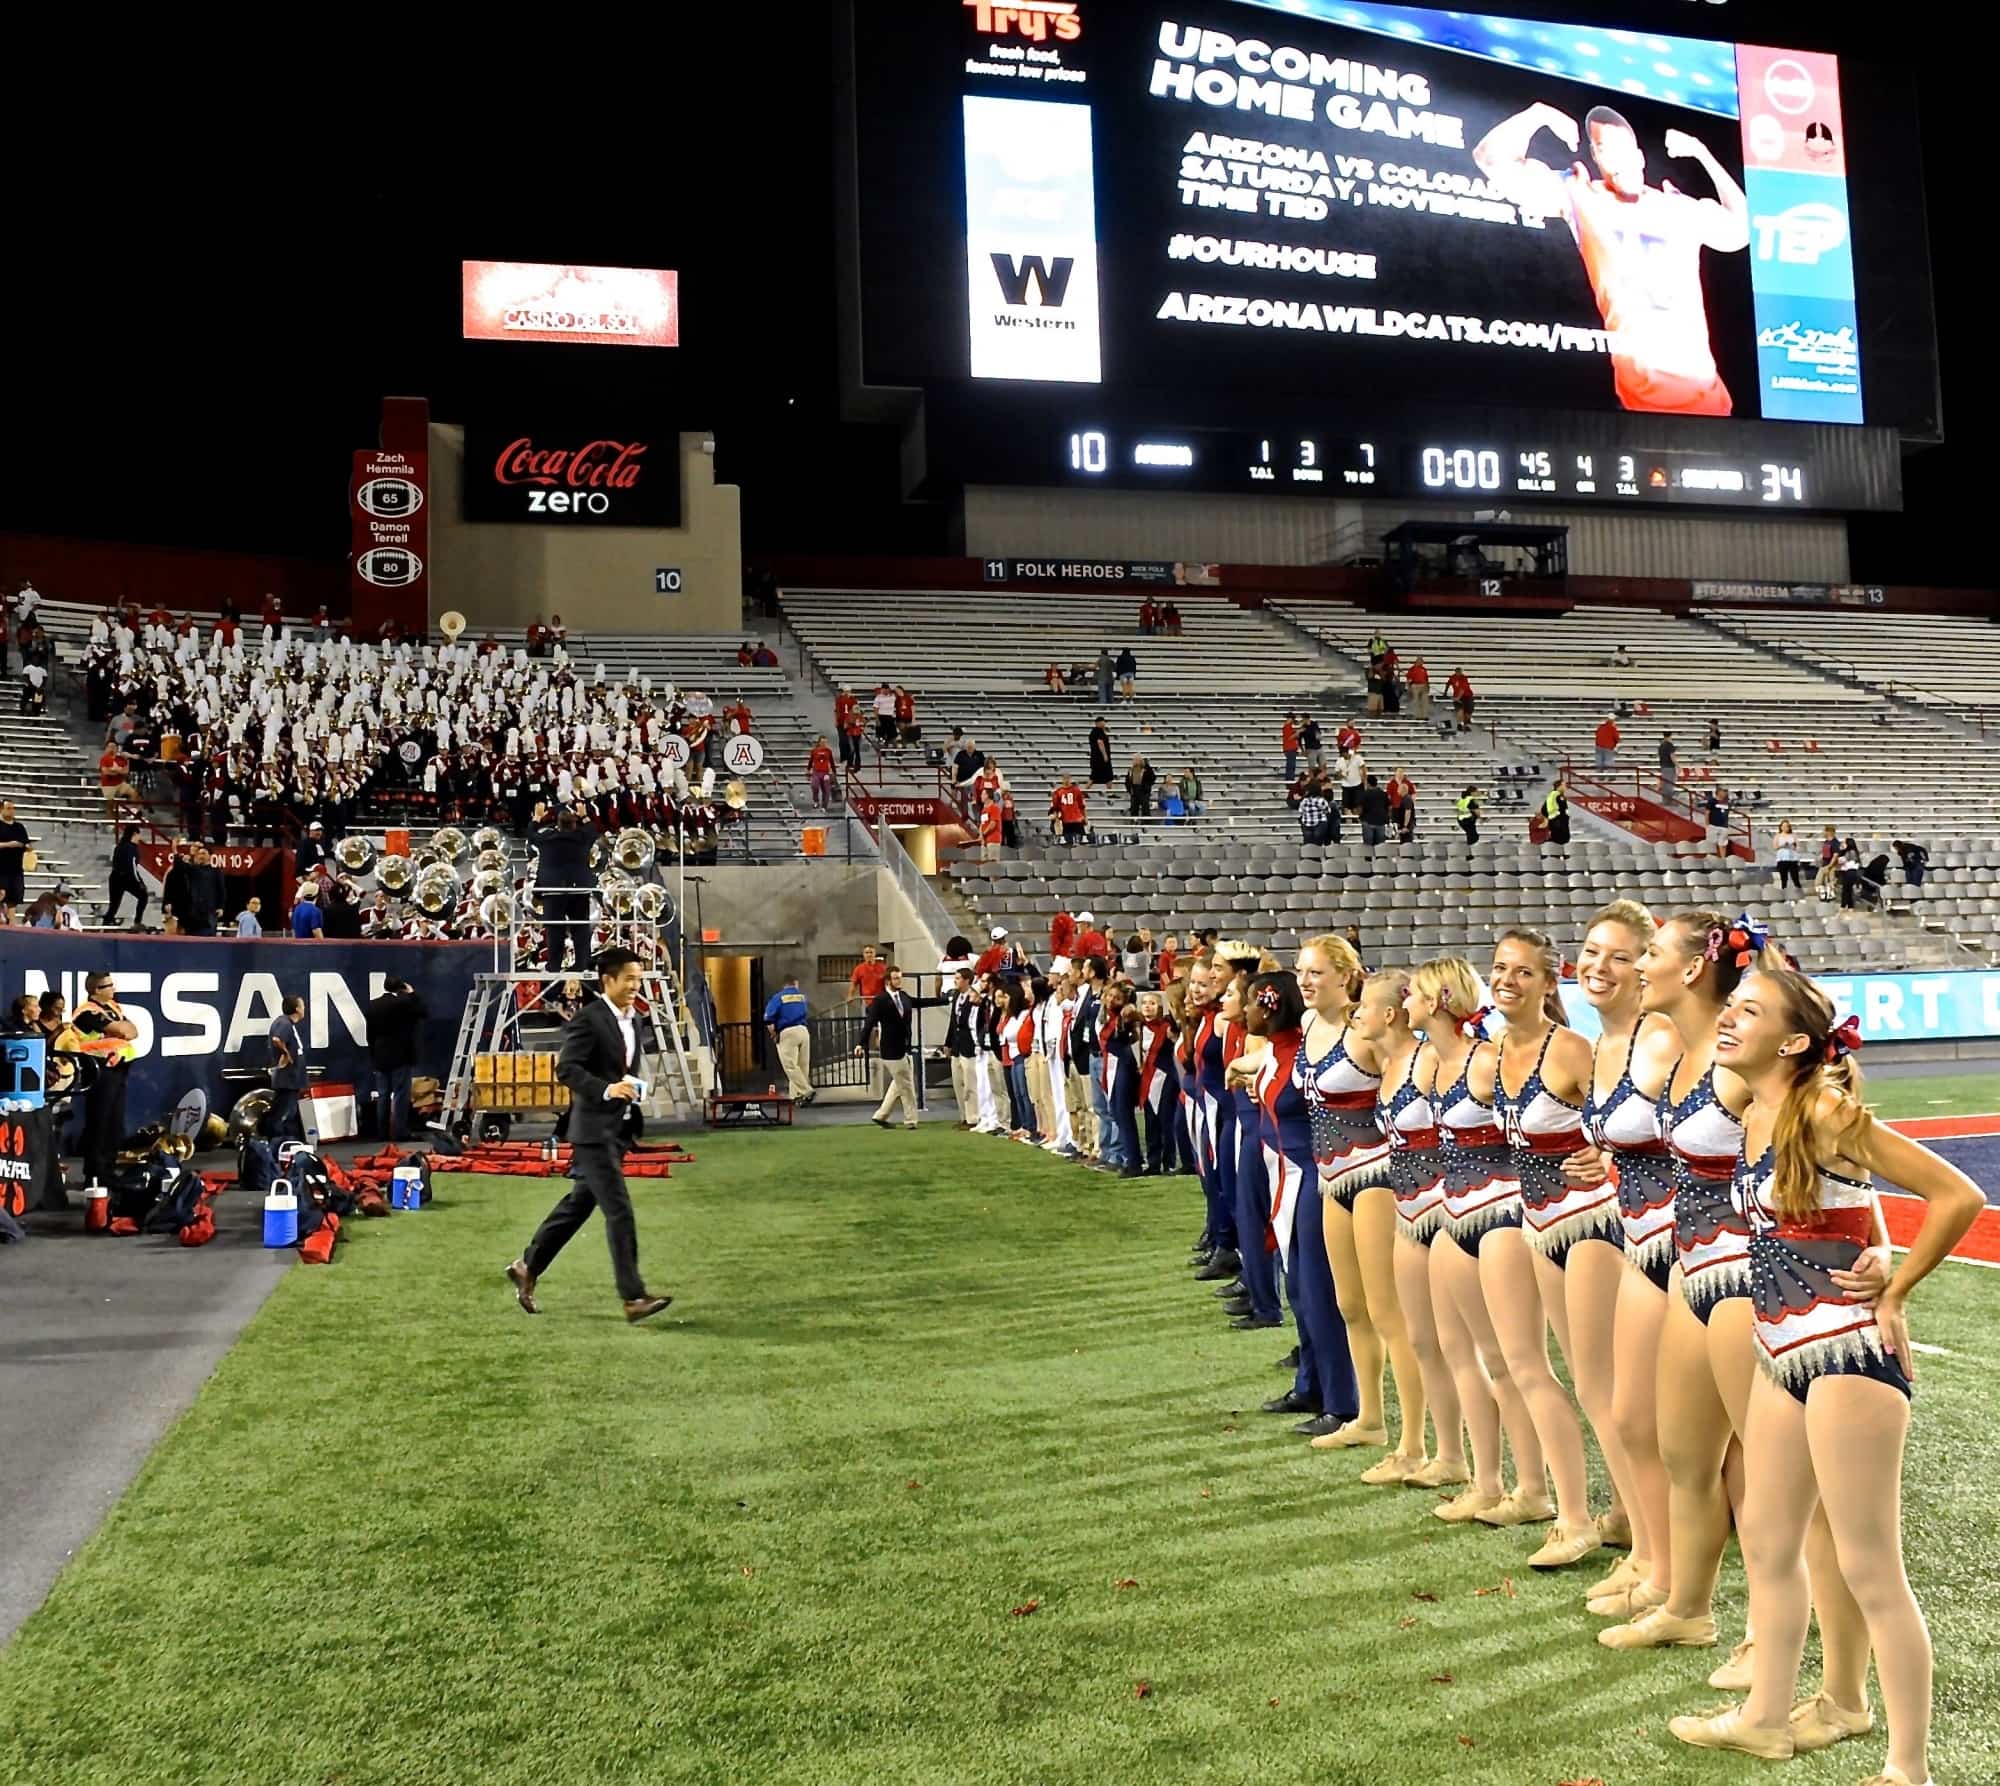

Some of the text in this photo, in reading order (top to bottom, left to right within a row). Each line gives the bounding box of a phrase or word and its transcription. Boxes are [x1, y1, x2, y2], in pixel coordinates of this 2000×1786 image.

[1158, 20, 1431, 106] UPCOMING
[1149, 59, 1465, 149] HOME GAME
[1183, 131, 1331, 174] ARIZONA
[1335, 154, 1375, 180] VS
[1179, 155, 1364, 207] SATURDAY,
[1177, 179, 1329, 221] TIME TBD
[1167, 234, 1378, 280] #OURHOUSE
[994, 314, 1076, 330] Western
[376, 452, 405, 463] Zach
[495, 438, 648, 488] Coca-Cola
[1071, 432, 1106, 471] 10
[1300, 440, 1315, 466] 3
[1359, 443, 1374, 467] 7
[366, 463, 415, 475] Hemmila
[1421, 448, 1500, 489] 0:00
[1519, 452, 1551, 477] 45
[1576, 455, 1592, 477] 4
[1617, 455, 1634, 480] 3
[1760, 464, 1802, 500] 34
[382, 493, 398, 504] 65
[528, 490, 609, 514] zero
[370, 521, 411, 532] Damon
[373, 532, 408, 544] Terrell
[382, 563, 399, 573] 80
[987, 562, 1004, 577] 11
[1016, 563, 1056, 577] FOLK
[1061, 564, 1125, 579] HEROES
[656, 571, 682, 590] 10
[1481, 580, 1502, 596] 12
[1867, 588, 1884, 603] 13
[731, 743, 756, 765] A
[878, 803, 915, 815] SECTION
[230, 854, 242, 868] 10
[25, 969, 386, 1058] NSSAN
